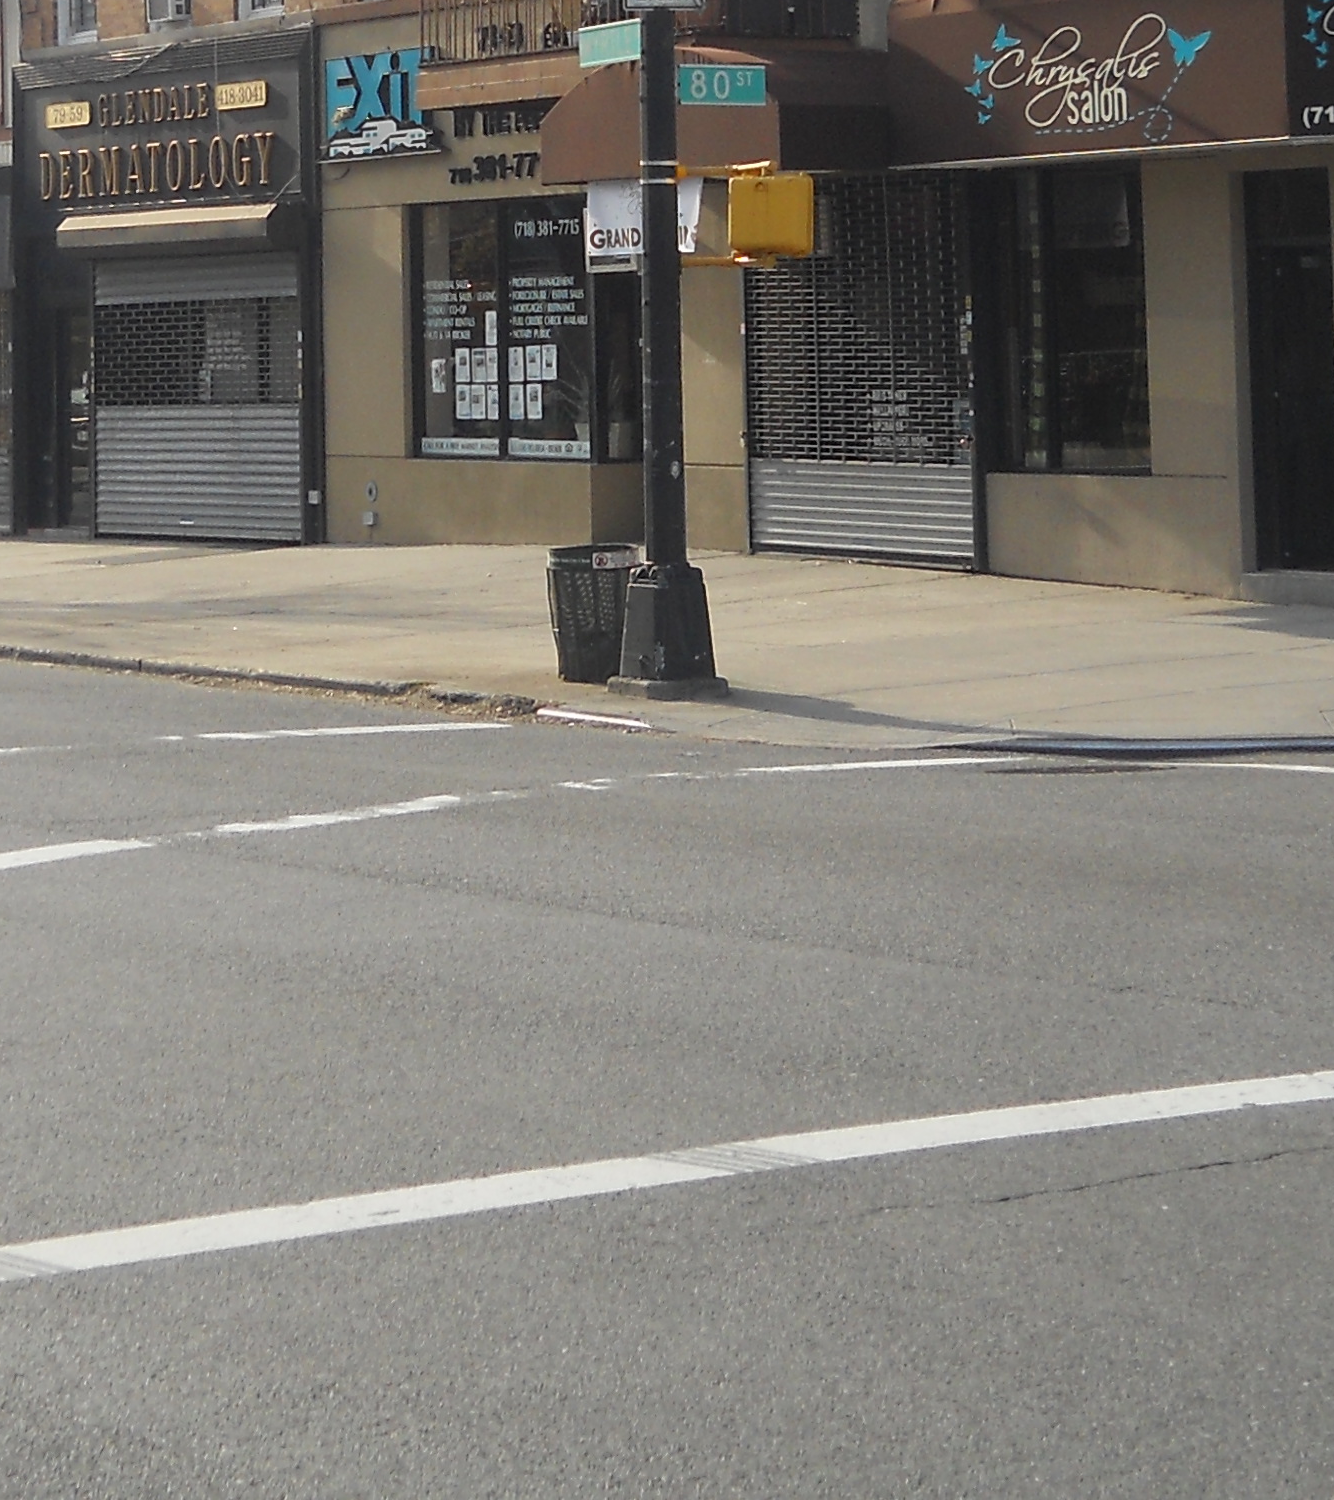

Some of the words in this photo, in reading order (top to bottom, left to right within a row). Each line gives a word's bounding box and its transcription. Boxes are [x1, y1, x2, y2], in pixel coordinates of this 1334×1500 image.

[690, 70, 731, 100] 80
[736, 71, 754, 87] ST
[987, 12, 1167, 128] Chrysalis
[97, 82, 210, 128] GLENDALE
[1067, 80, 1129, 125] salon
[39, 131, 275, 201] DERMATOLOGY
[590, 227, 642, 249] GRAND
